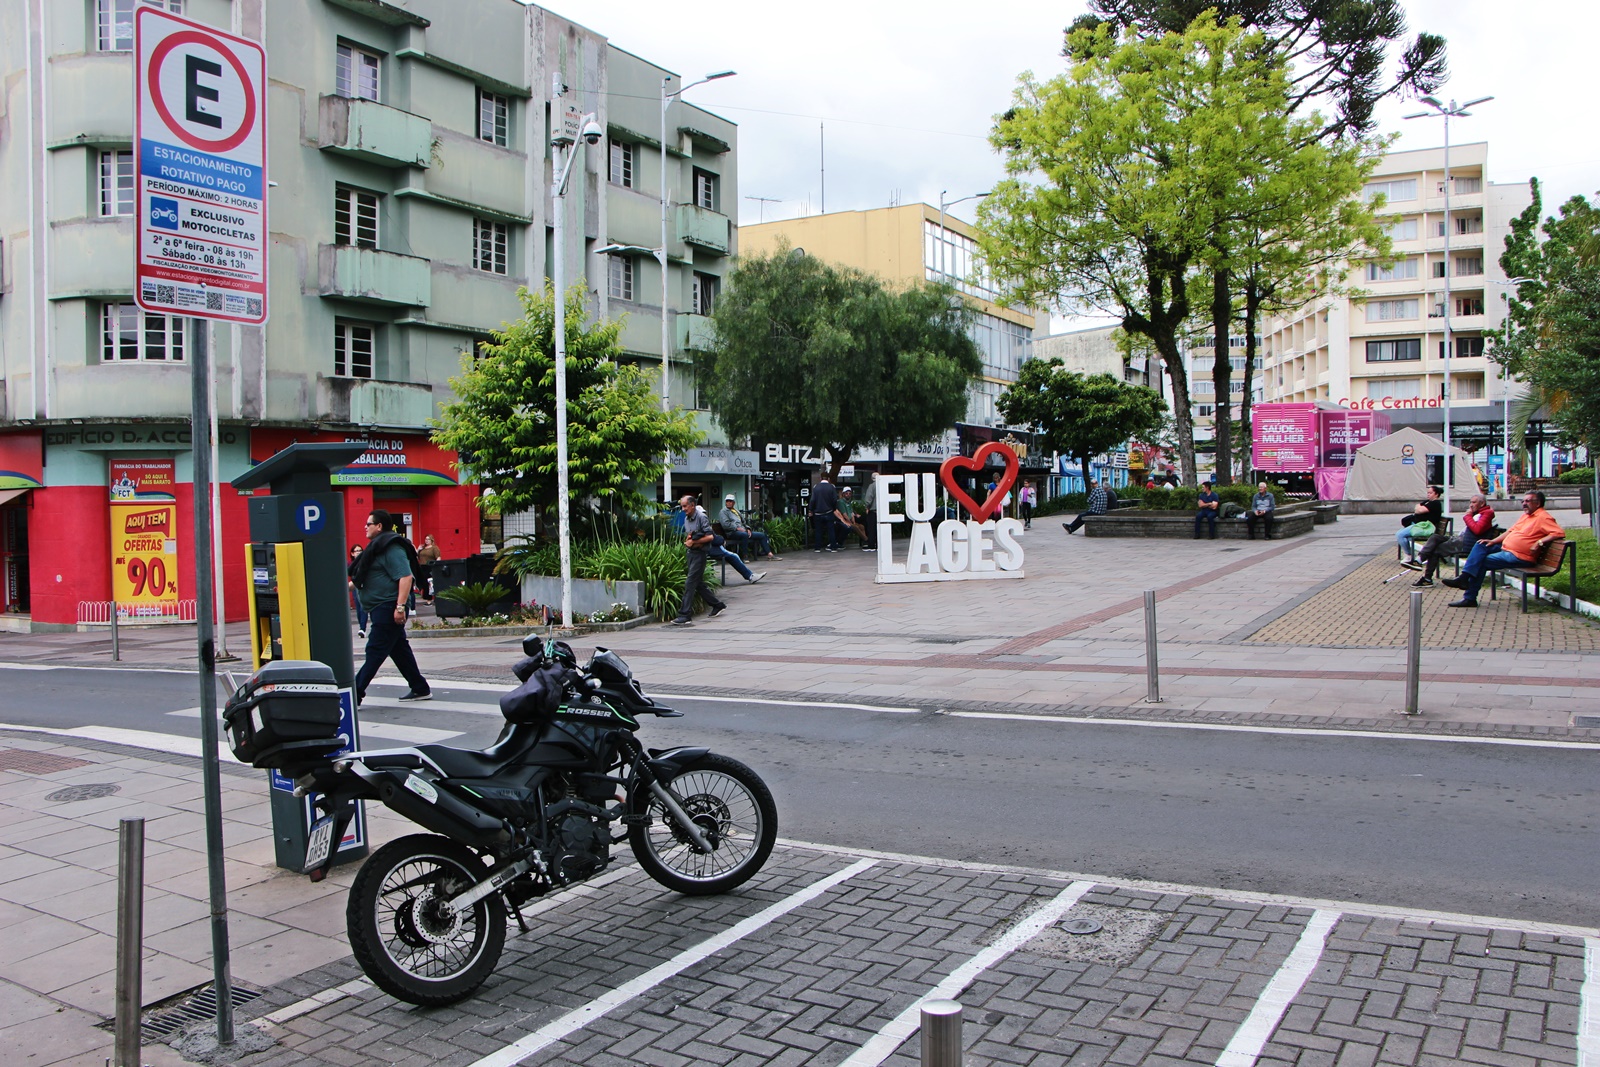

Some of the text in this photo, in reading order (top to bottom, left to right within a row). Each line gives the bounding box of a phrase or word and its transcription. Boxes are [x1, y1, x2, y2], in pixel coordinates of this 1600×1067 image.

[186, 54, 222, 129] E
[154, 146, 252, 178] ESTACIONAMENTO
[161, 165, 246, 193] ROTATIVO PAGO
[147, 180, 258, 209] PERÍODO MÁXIMO: 2 HORAS
[190, 208, 245, 226] EXCLUSIVO
[181, 220, 256, 241] MOTOCICLETAS
[162, 247, 196, 261] Sábado
[203, 254, 214, 264] 08
[217, 256, 227, 266] às
[230, 259, 246, 269] 13h
[184, 240, 205, 252] feira
[212, 246, 223, 255] 08
[225, 248, 236, 257] às
[239, 251, 254, 261] 19h
[1382, 395, 1442, 409] Central
[47, 430, 115, 445] EDIFÍCIO
[1262, 423, 1295, 433] SAÚDE
[391, 440, 404, 450] DO
[1262, 435, 1304, 443] MULHER
[734, 456, 753, 468] Ótica
[766, 443, 821, 464] BLITZ
[876, 473, 937, 522] EU
[127, 512, 166, 529] AQUI TEM
[304, 505, 320, 530] P
[124, 539, 162, 551] OFERTAS
[877, 518, 1024, 574] LAGES
[127, 556, 166, 597] 90
